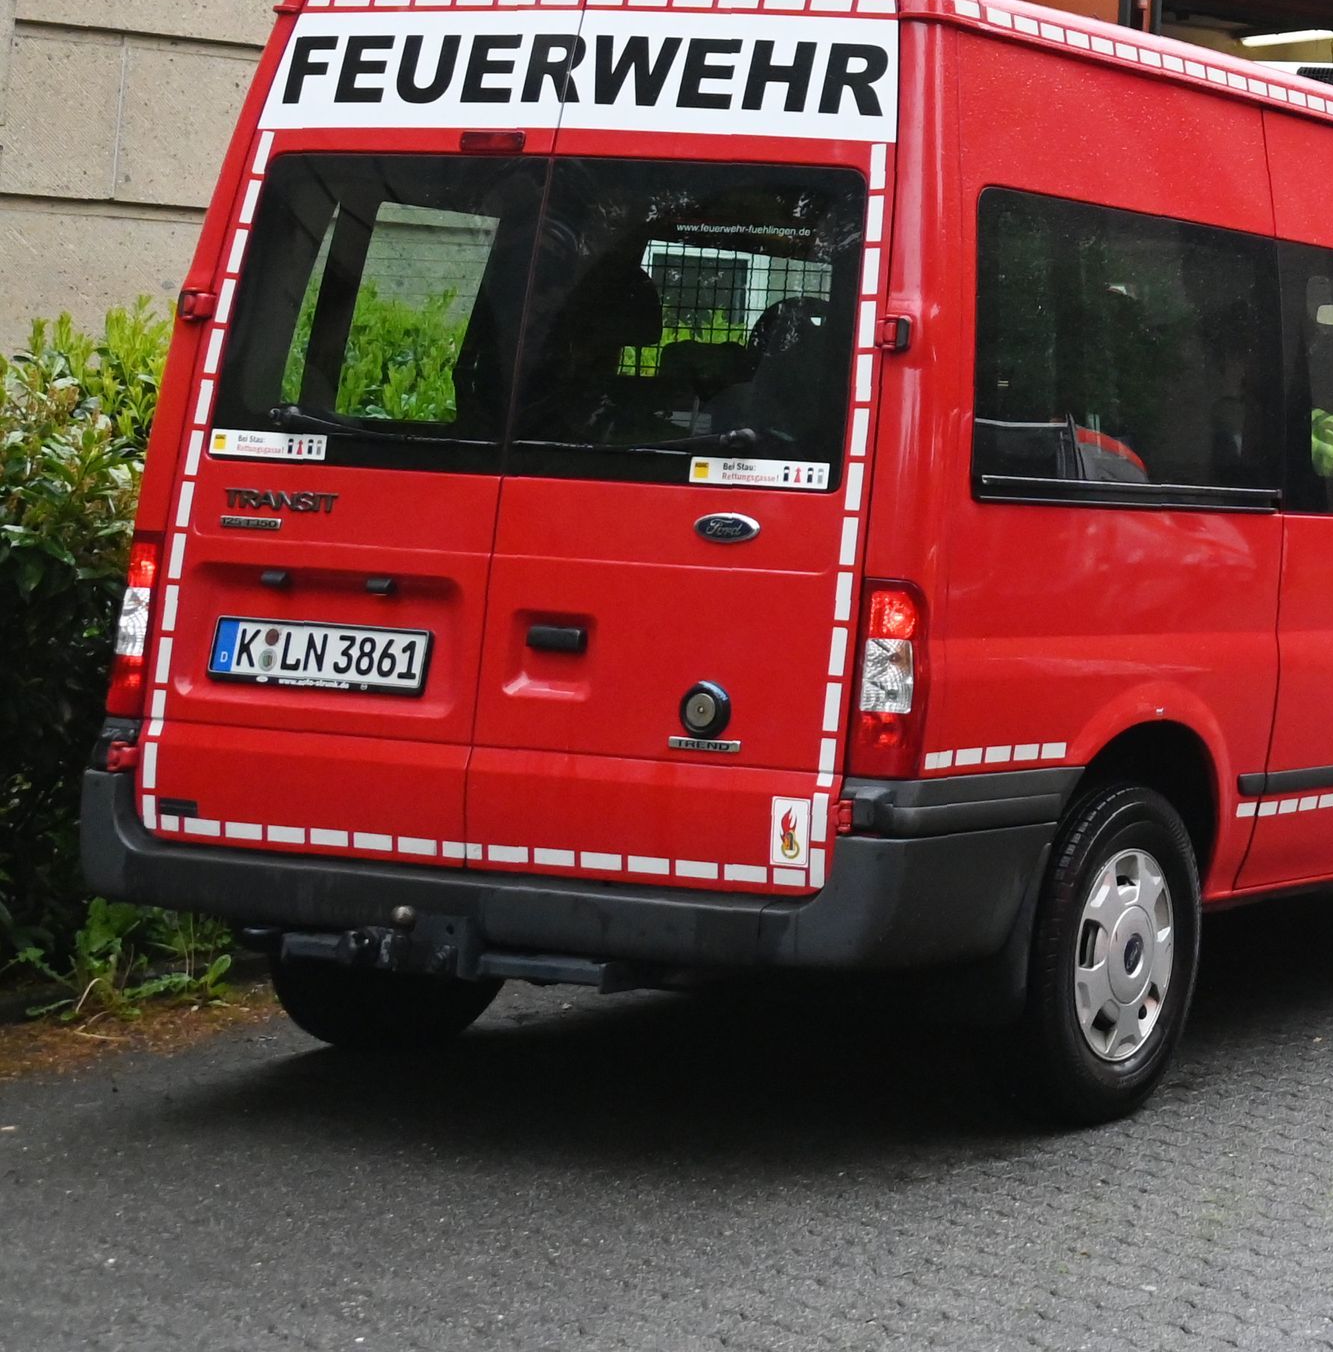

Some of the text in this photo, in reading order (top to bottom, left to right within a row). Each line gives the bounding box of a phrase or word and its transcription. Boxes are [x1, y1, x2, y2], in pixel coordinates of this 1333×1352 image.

[281, 33, 890, 117] FEUERWEHR
[676, 223, 811, 237] www.feuerwehr-fuehlingen.de
[722, 462, 735, 471] Bei
[225, 488, 338, 513] TRANSIT
[219, 628, 417, 680] D K LN 3861
[678, 740, 730, 750] TREND
